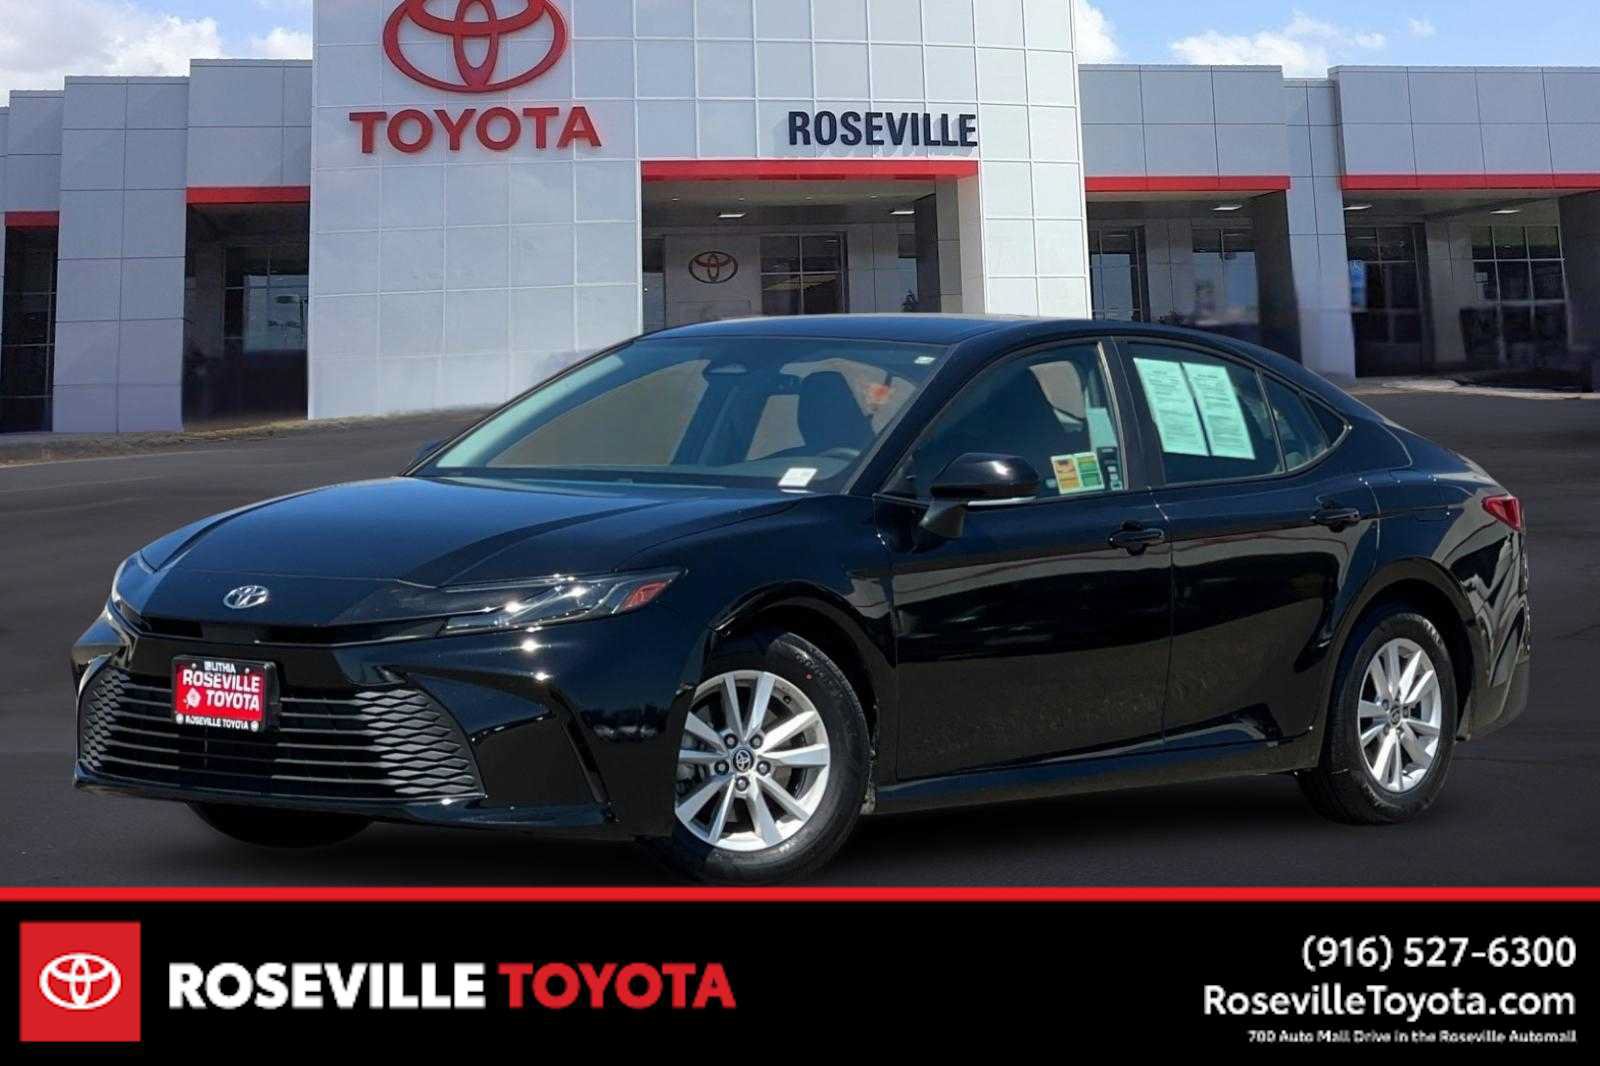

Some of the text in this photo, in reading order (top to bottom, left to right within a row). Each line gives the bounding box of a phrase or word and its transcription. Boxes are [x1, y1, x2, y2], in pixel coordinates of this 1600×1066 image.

[350, 106, 602, 153] TOYOTA
[789, 111, 978, 147] ROSEVILLE
[182, 669, 261, 693] ROSEVILLE
[206, 689, 260, 711] TOYOTA
[185, 714, 249, 730] ROSEVILLE TOYOTA
